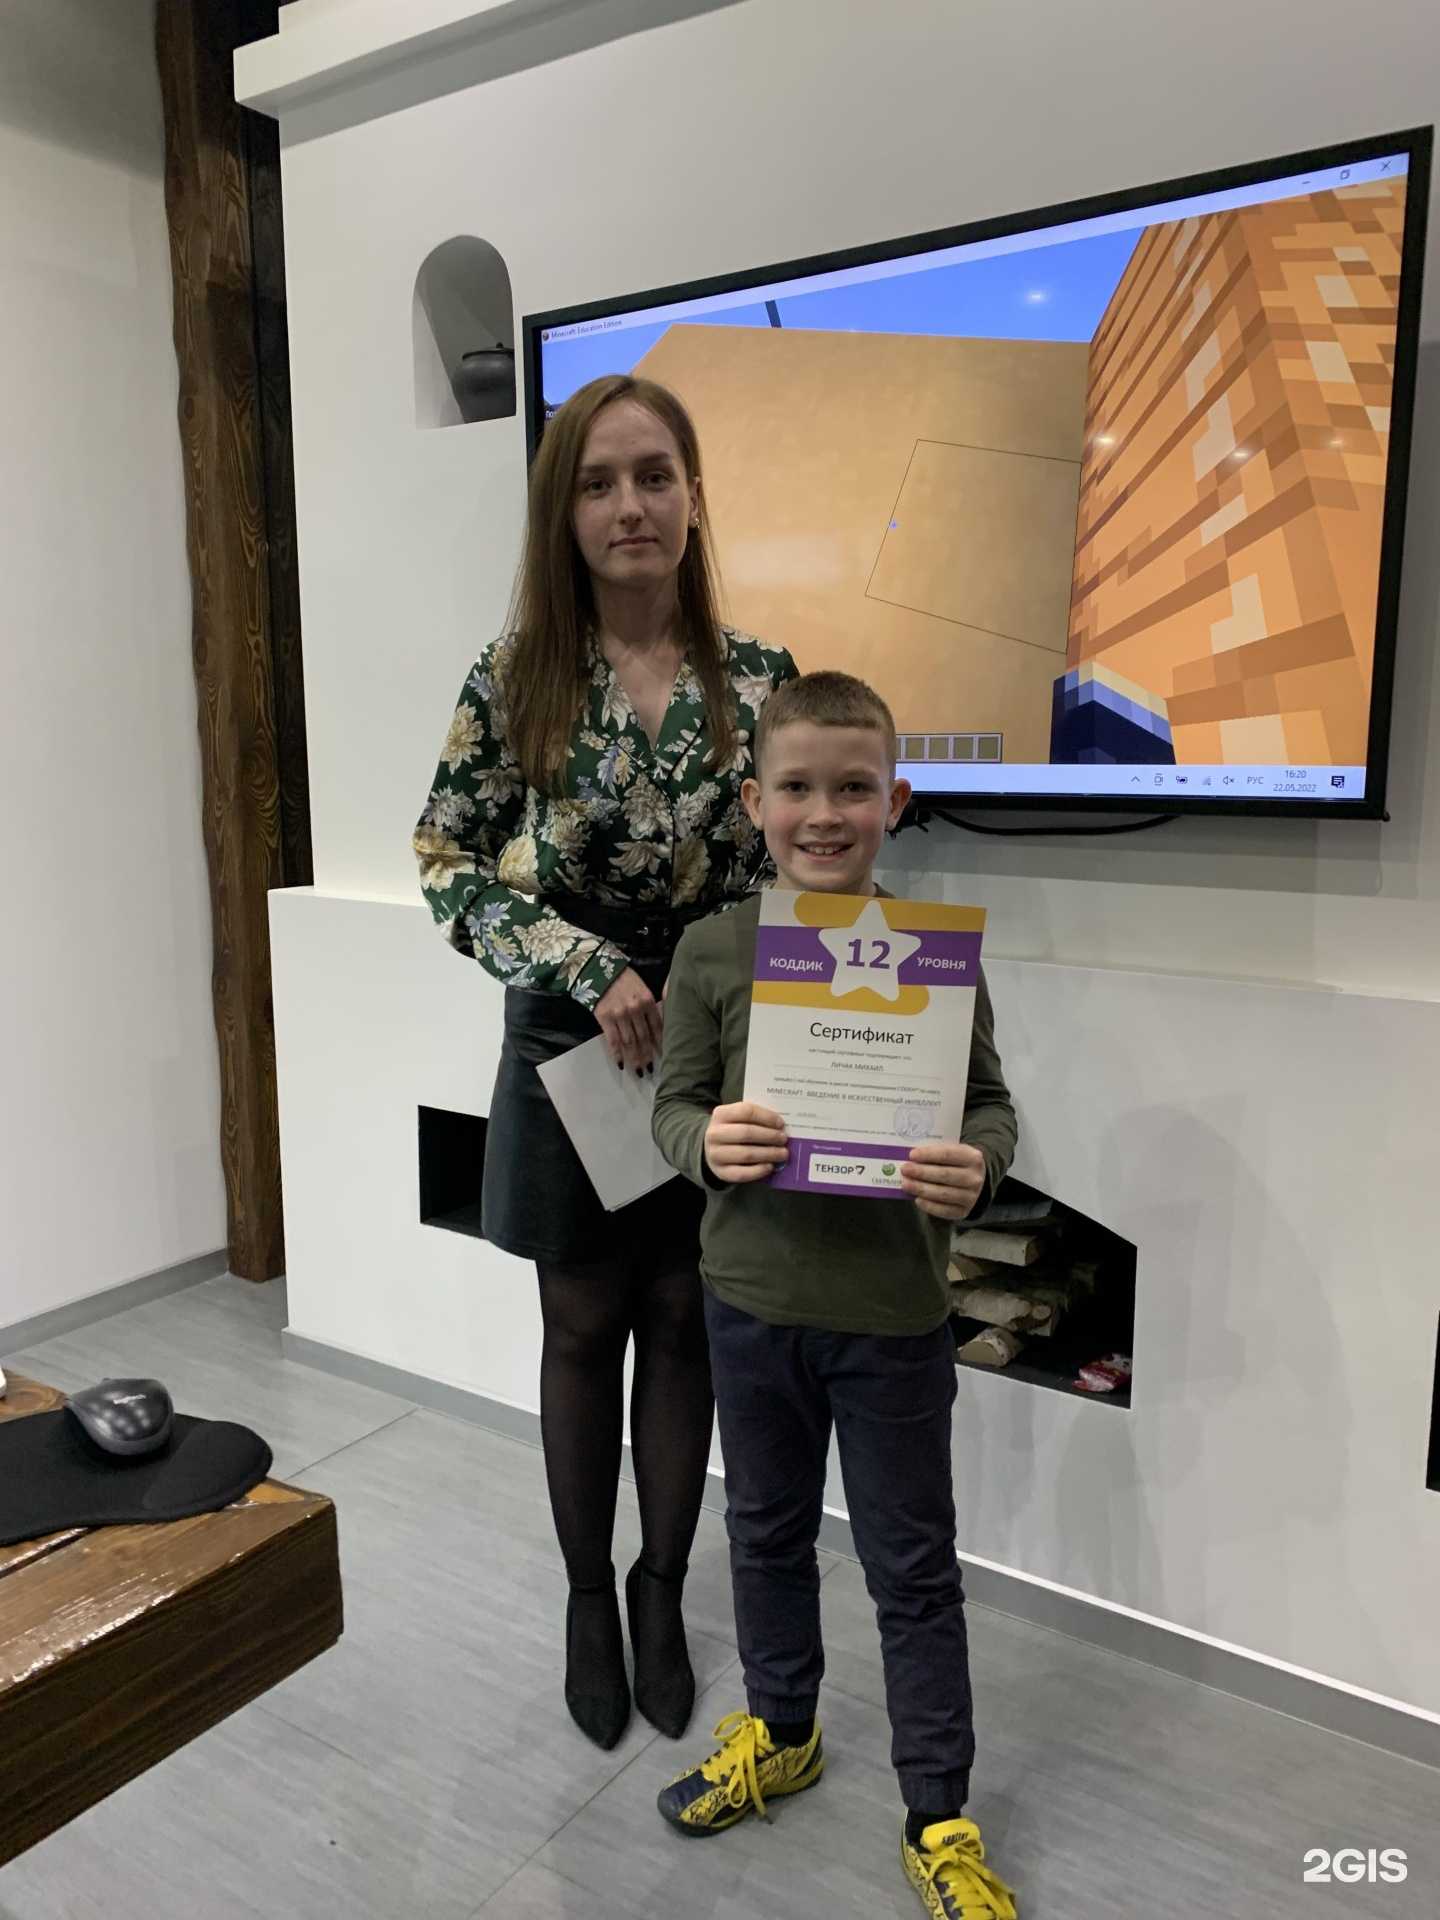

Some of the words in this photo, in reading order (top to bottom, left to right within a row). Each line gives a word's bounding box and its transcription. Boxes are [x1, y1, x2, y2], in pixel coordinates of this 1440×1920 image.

[1285, 769, 1307, 779] 16:20
[1247, 776, 1264, 785] РУС
[1273, 783, 1317, 793] 22.05.2022
[769, 957, 824, 971] КОДДИК
[846, 938, 891, 970] 12
[917, 956, 967, 971] УРОВНЯ
[810, 1022, 914, 1045] Сертификат
